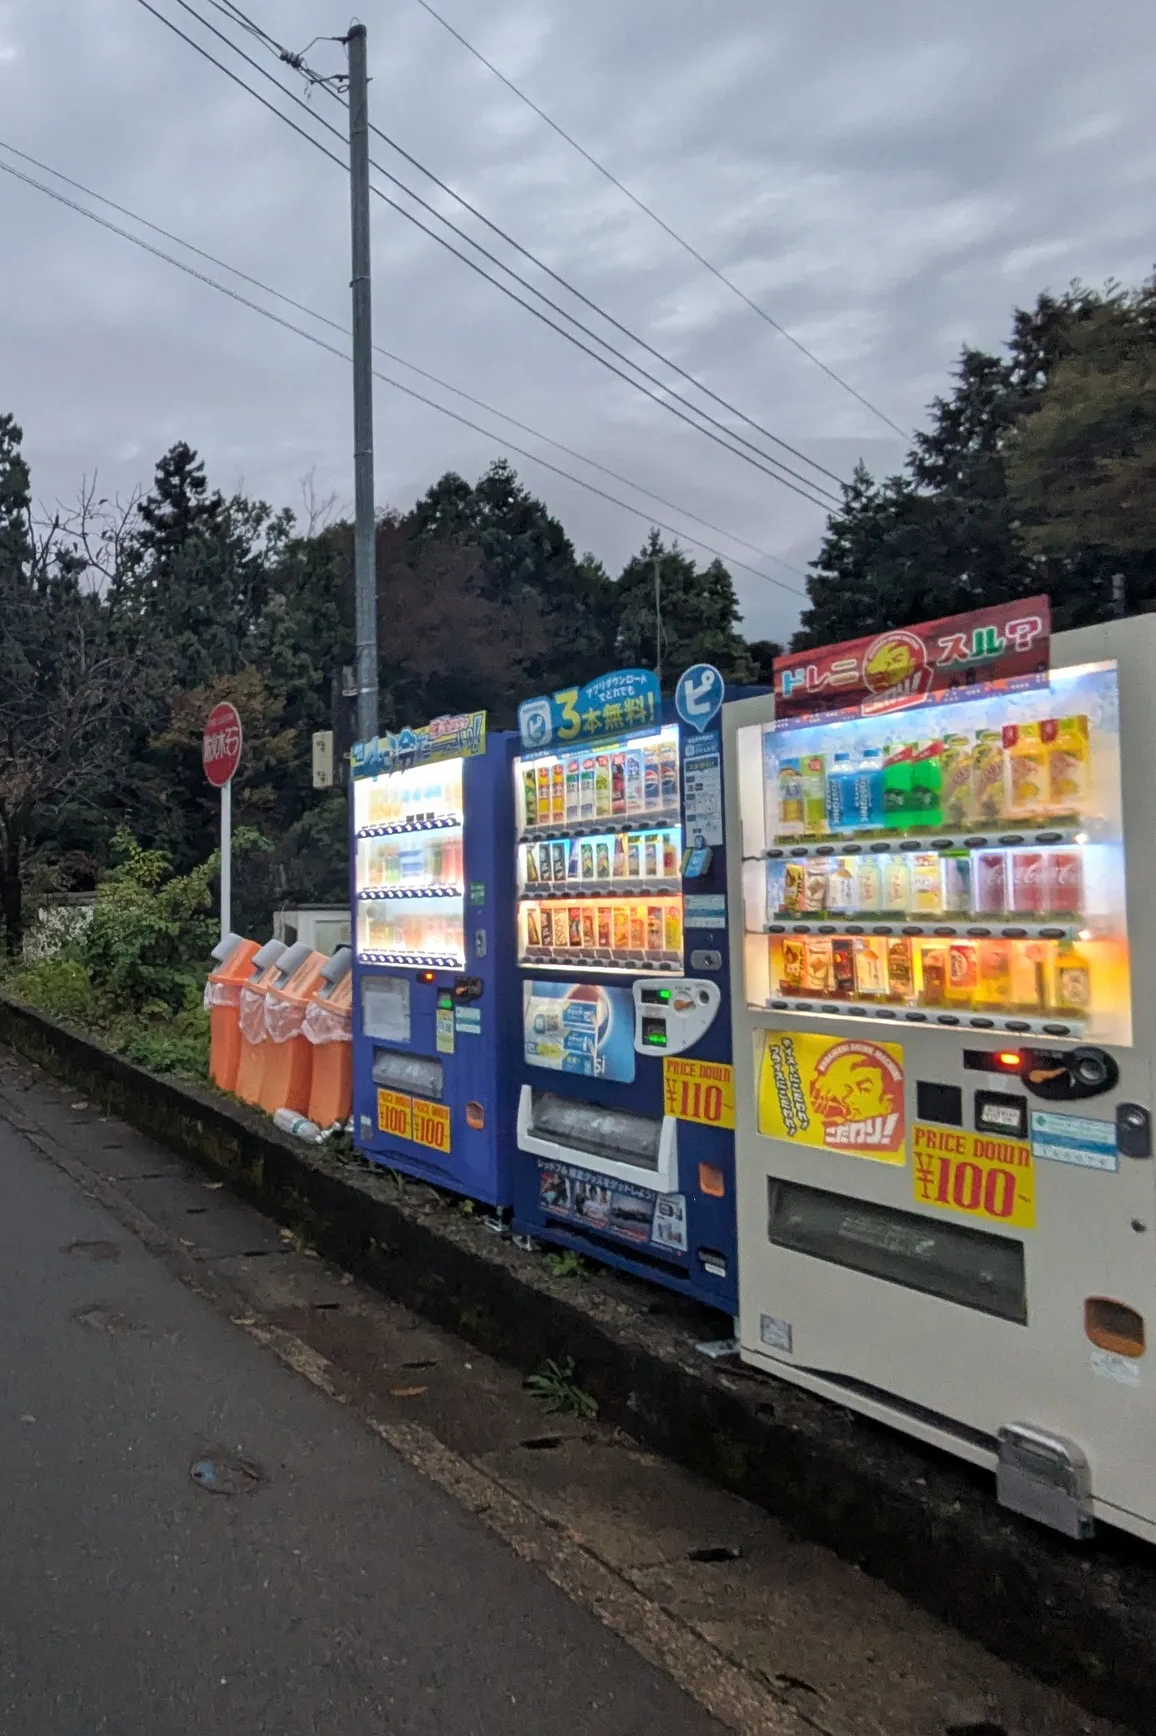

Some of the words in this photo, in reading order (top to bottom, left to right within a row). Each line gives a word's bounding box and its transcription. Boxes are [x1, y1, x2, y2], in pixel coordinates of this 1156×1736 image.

[684, 669, 715, 715] ピ
[667, 1060, 697, 1077] PRICE
[914, 1127, 966, 1155] PRICE
[973, 1138, 1031, 1167] DOWN
